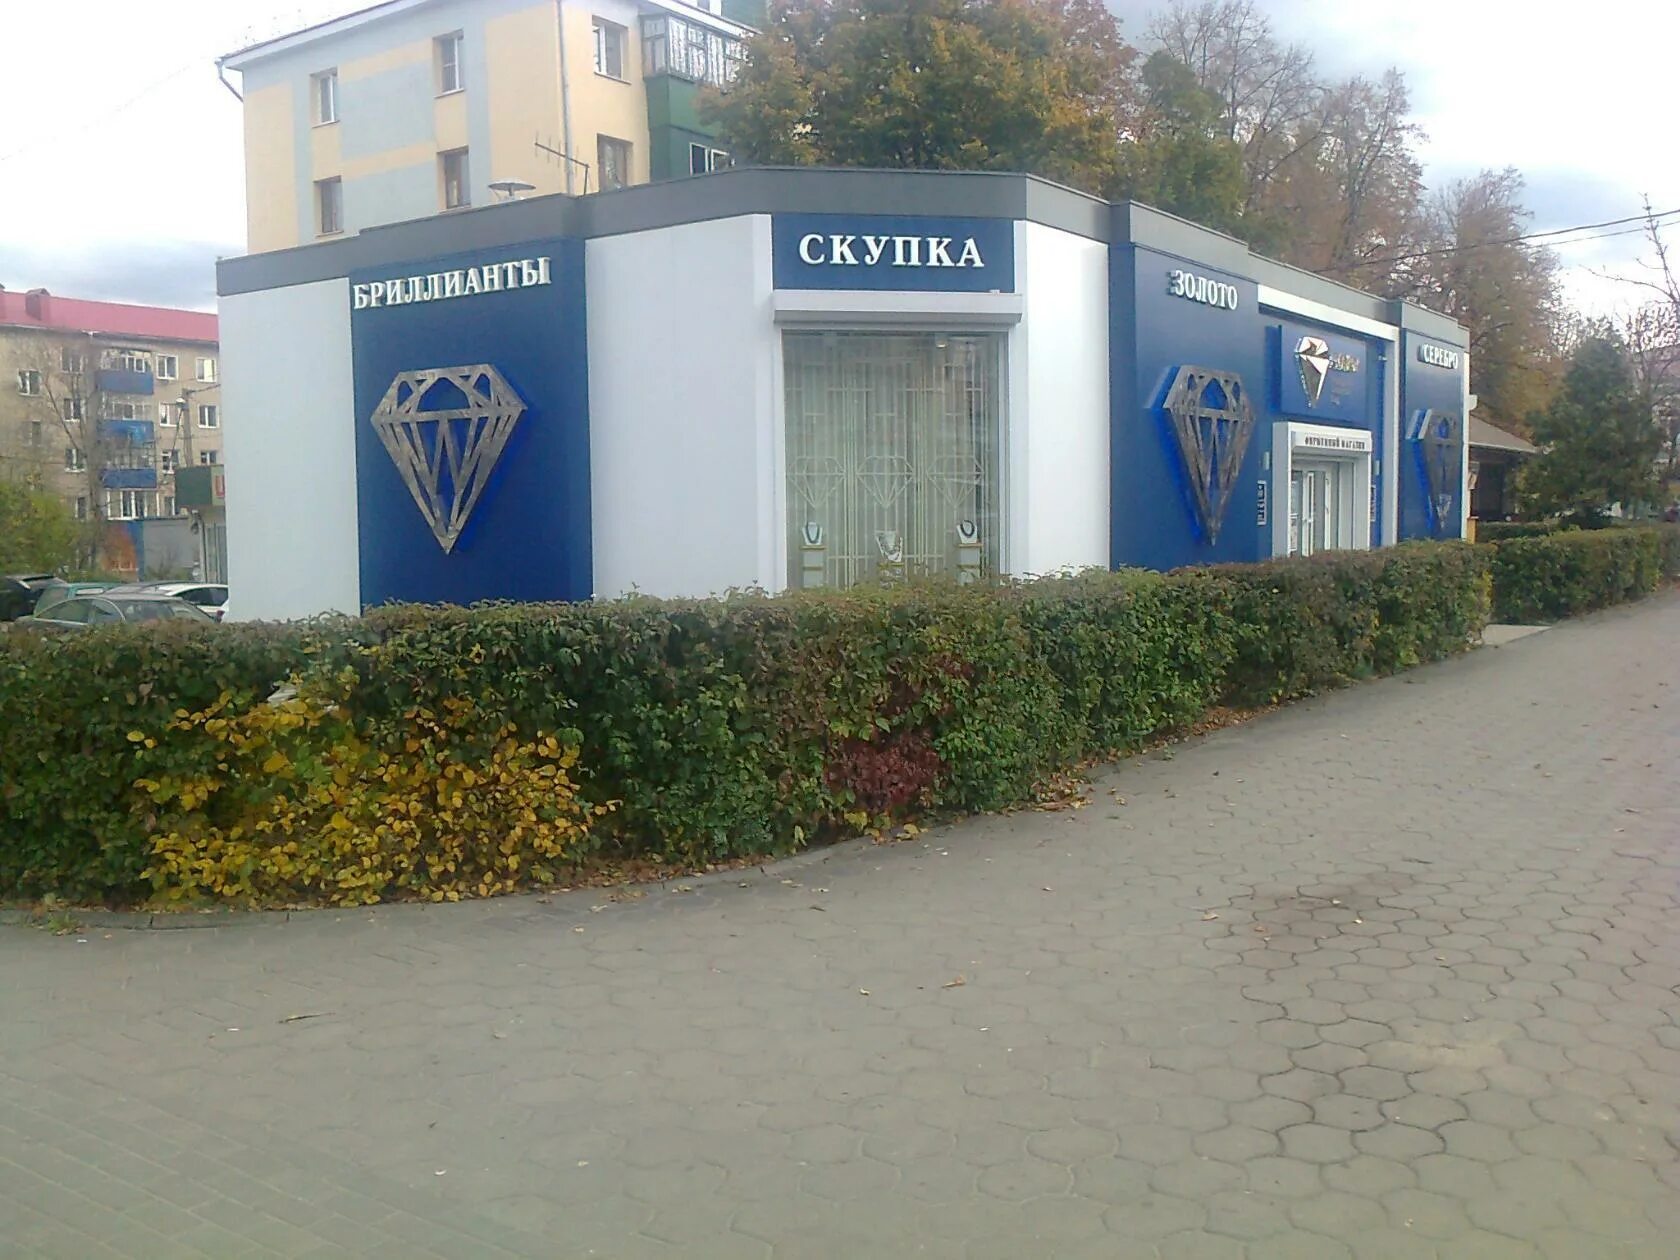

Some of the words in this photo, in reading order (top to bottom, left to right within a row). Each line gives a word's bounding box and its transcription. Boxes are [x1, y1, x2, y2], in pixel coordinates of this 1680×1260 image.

[799, 233, 985, 268] СКУПКА
[353, 256, 552, 310] БРИЛЛИАНТЫ
[1172, 269, 1238, 310] ЗОЛОТО
[1422, 343, 1459, 370] СЕРЕБРО
